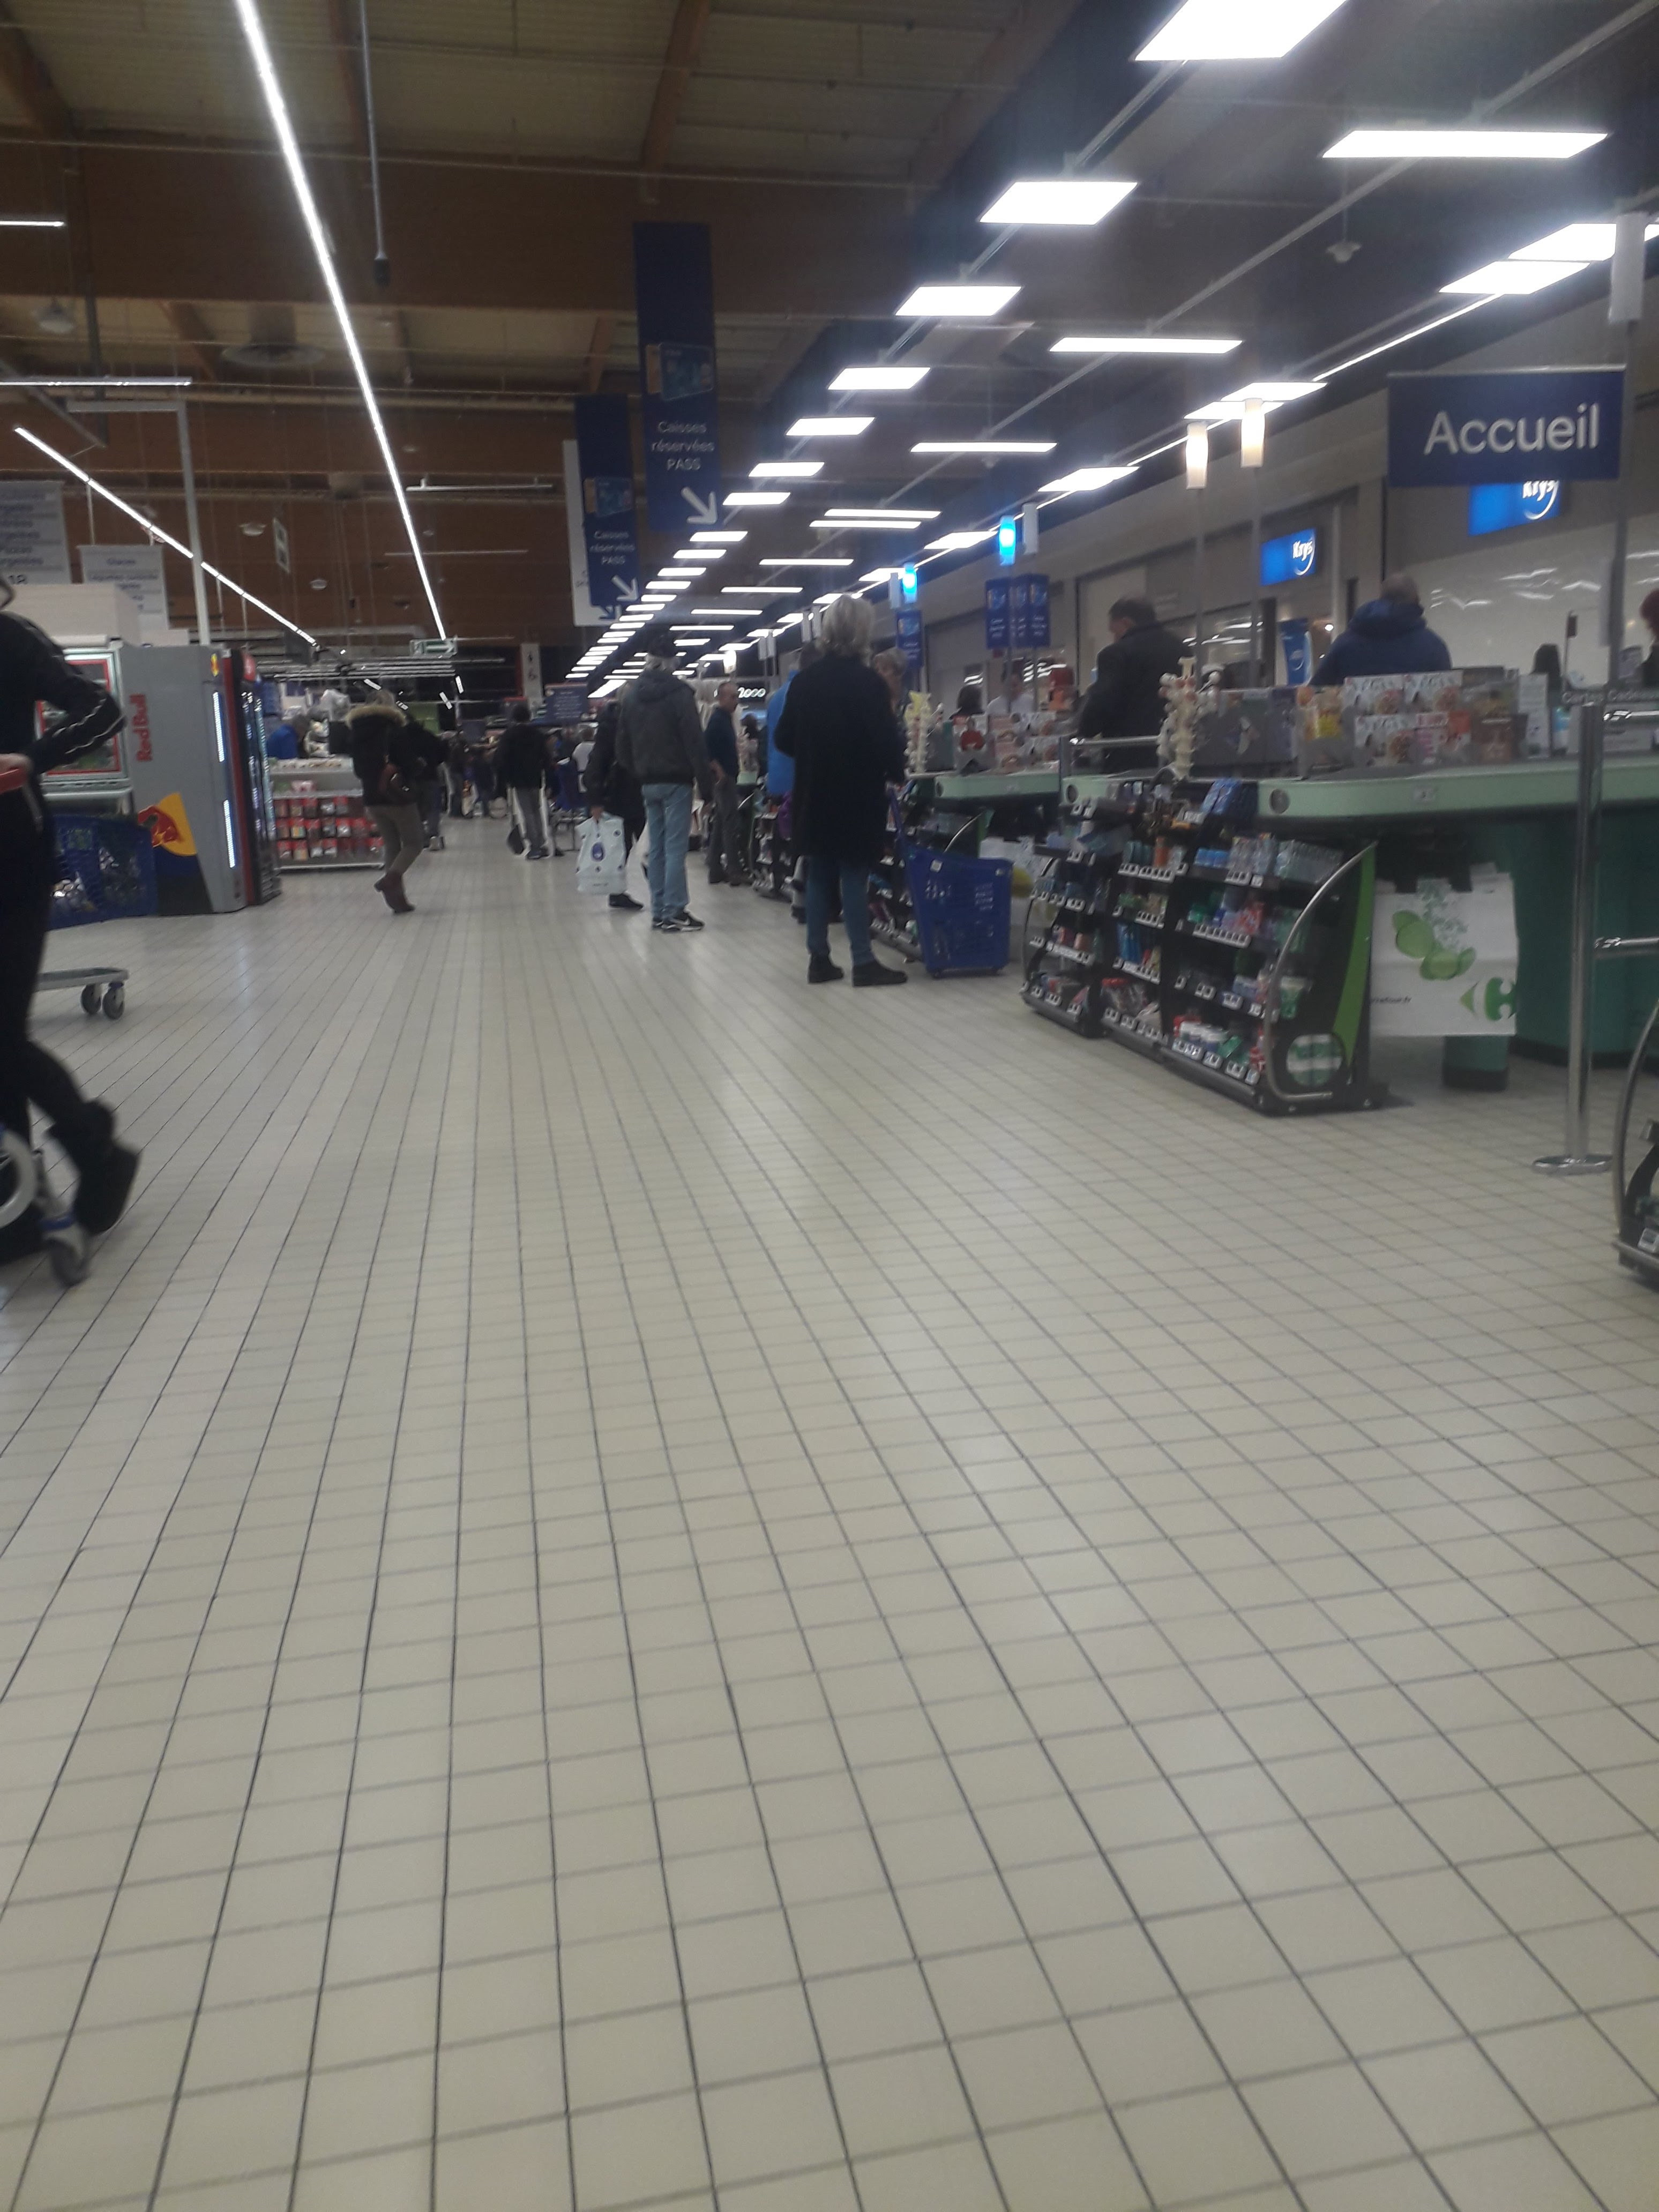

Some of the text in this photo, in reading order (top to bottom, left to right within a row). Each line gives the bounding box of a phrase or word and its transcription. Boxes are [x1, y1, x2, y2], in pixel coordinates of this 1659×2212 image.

[1423, 402, 1600, 455] Accueil
[667, 459, 701, 470] PASS
[738, 687, 766, 698] 2000
[130, 693, 152, 761] Red Bull
